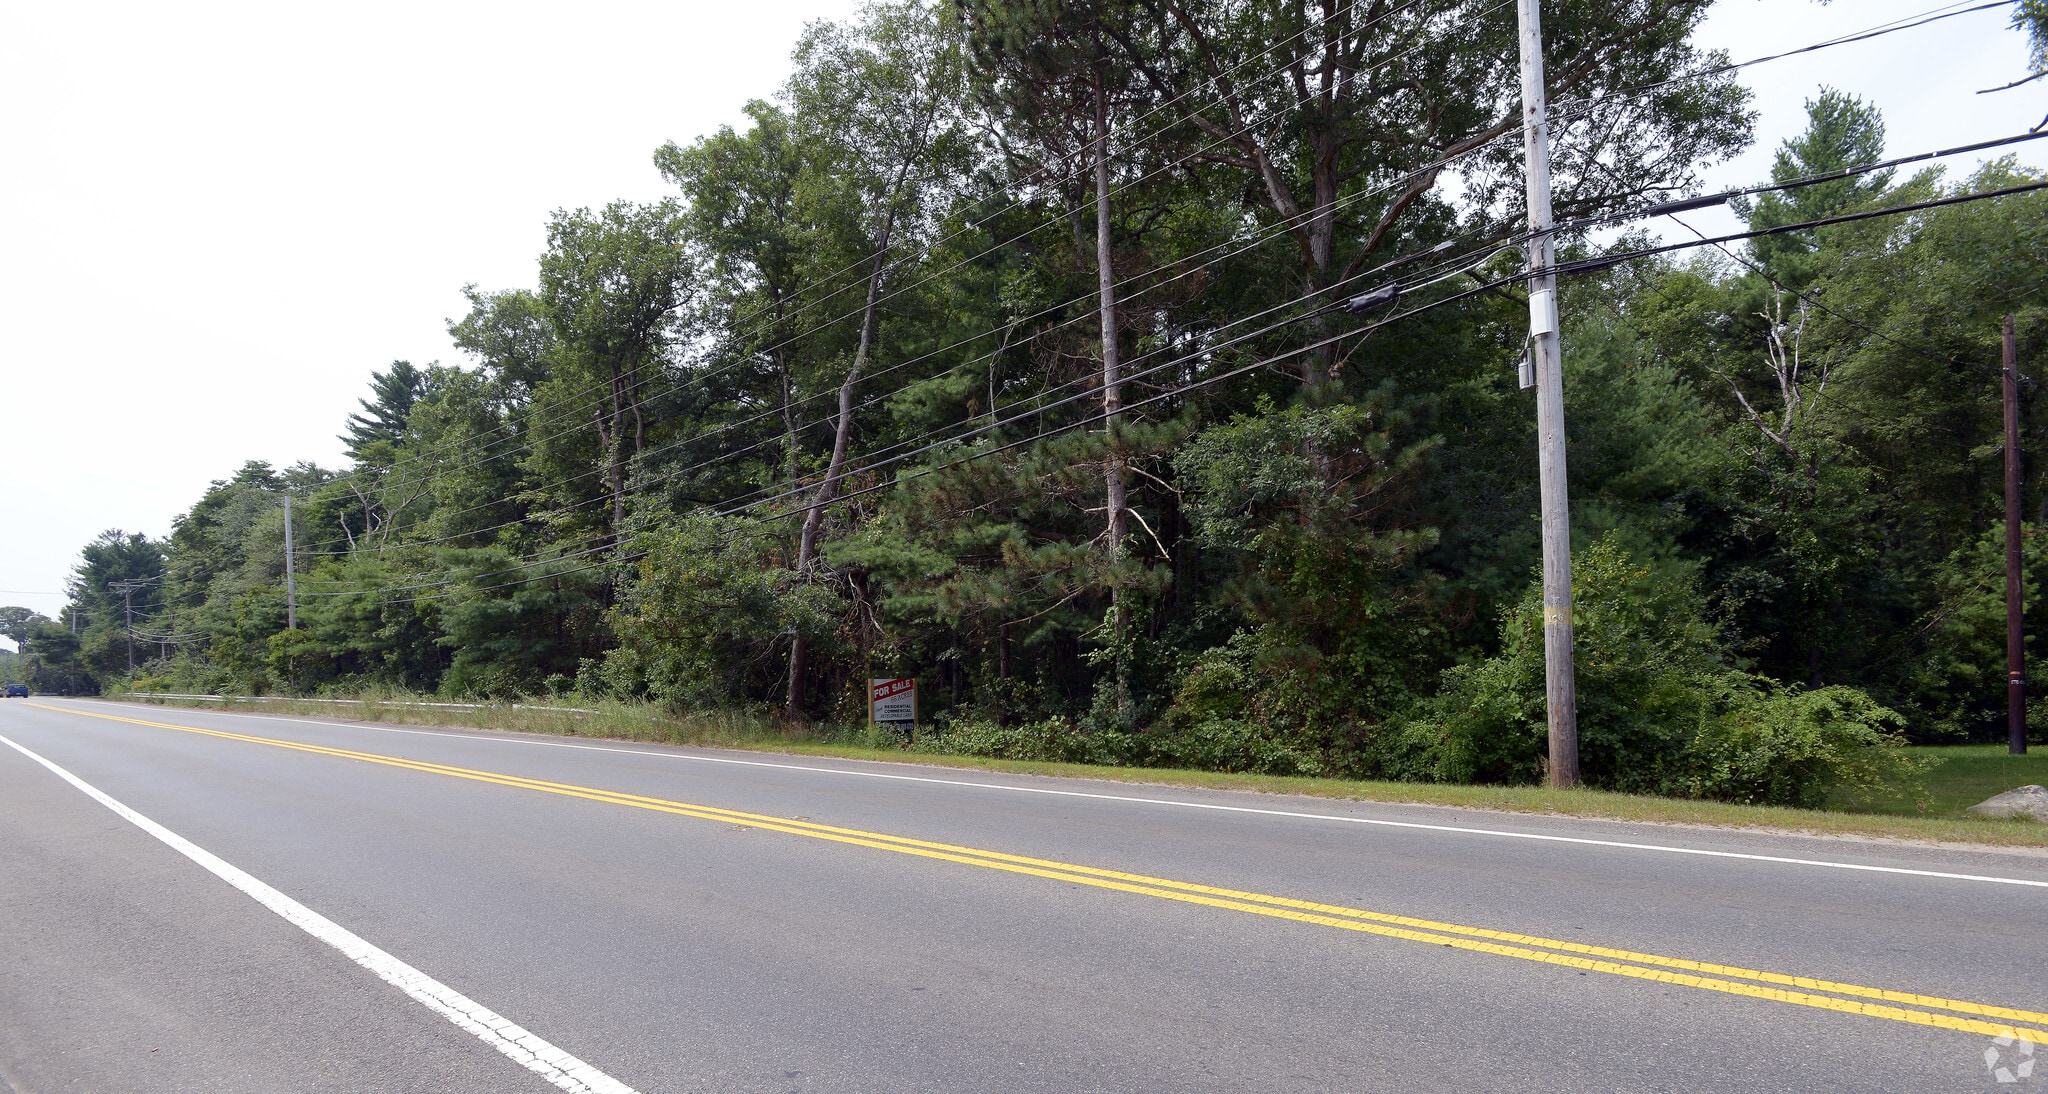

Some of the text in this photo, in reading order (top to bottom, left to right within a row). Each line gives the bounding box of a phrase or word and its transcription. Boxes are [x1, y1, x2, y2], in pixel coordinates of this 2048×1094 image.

[874, 680, 910, 698] FOR SALE
[898, 691, 912, 700] ACRES
